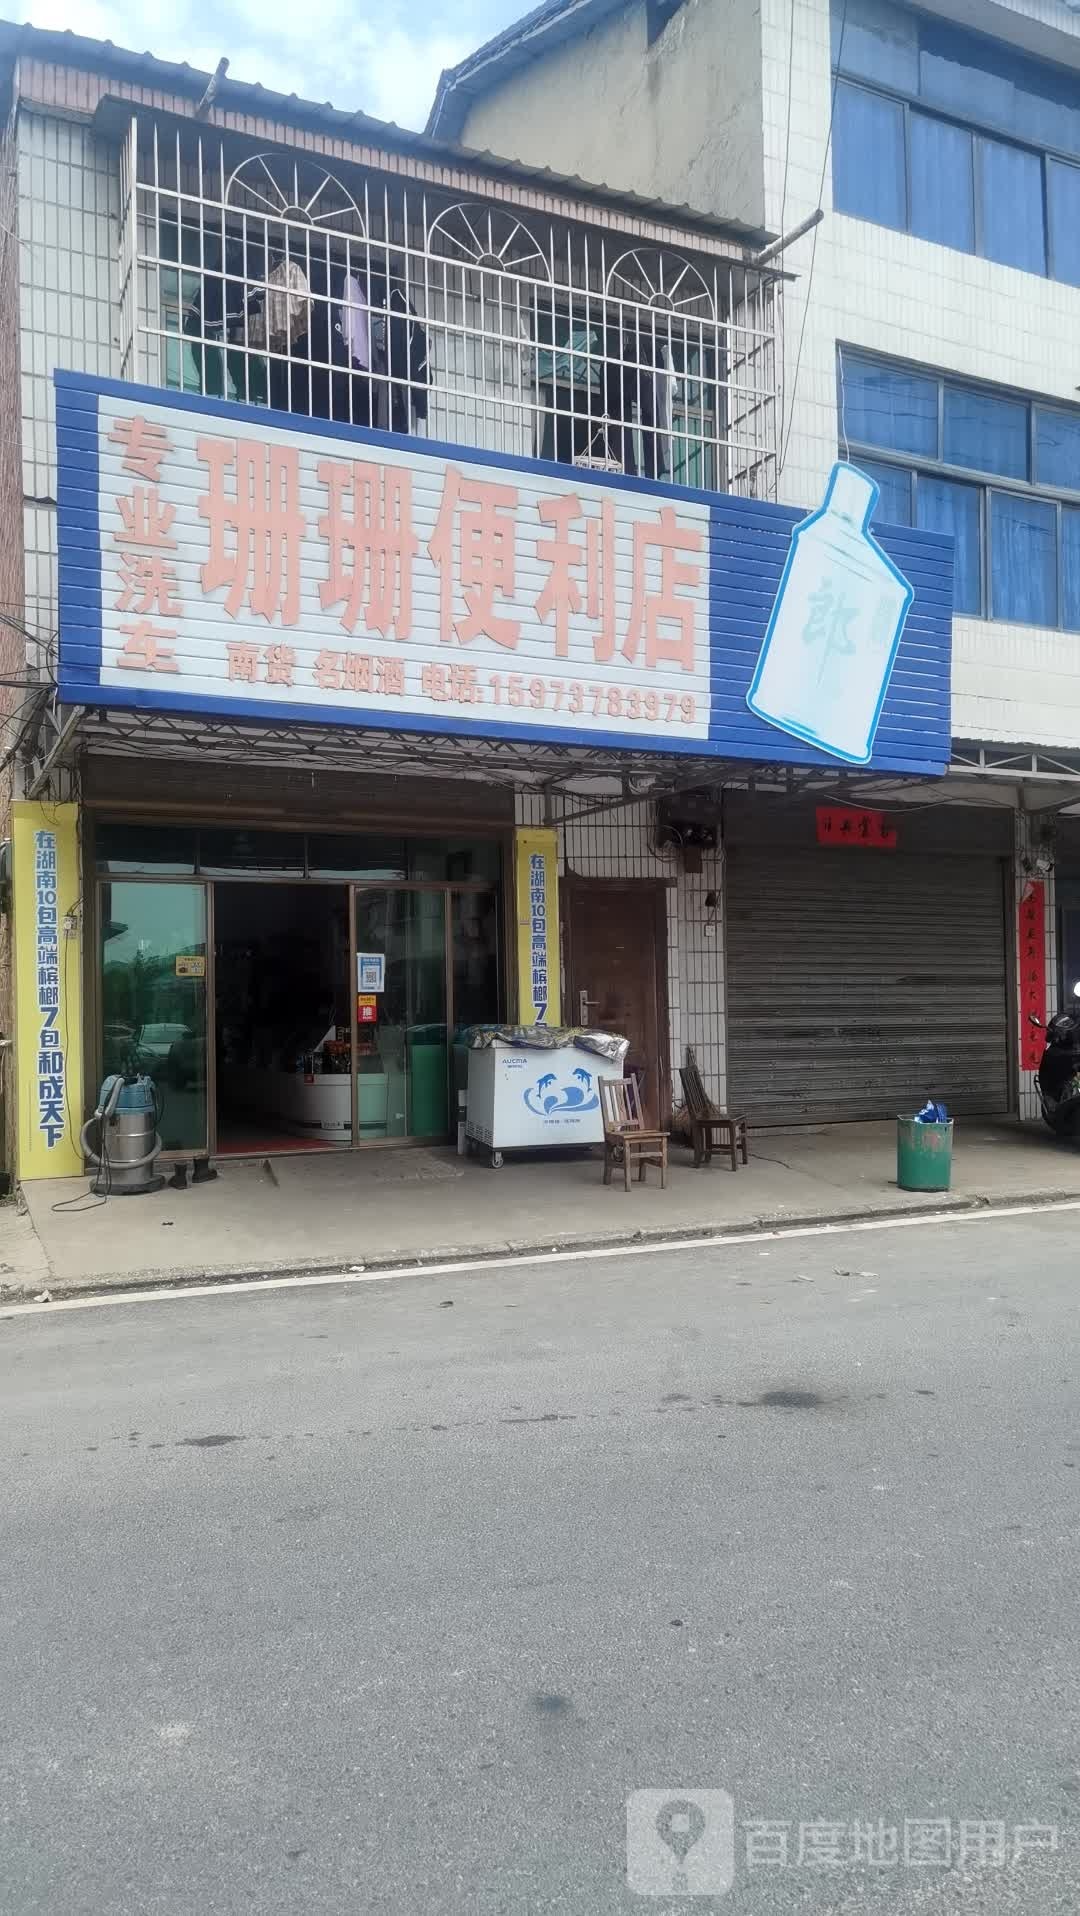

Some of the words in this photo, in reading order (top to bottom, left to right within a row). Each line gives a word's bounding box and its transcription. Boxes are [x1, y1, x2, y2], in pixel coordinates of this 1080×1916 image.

[108, 415, 184, 673] 专业洗车
[196, 438, 703, 672] 珊珊便利店
[312, 649, 405, 696] 名烟酒
[36, 829, 65, 1149] 在湖南10包高端槟榔7包和成天下
